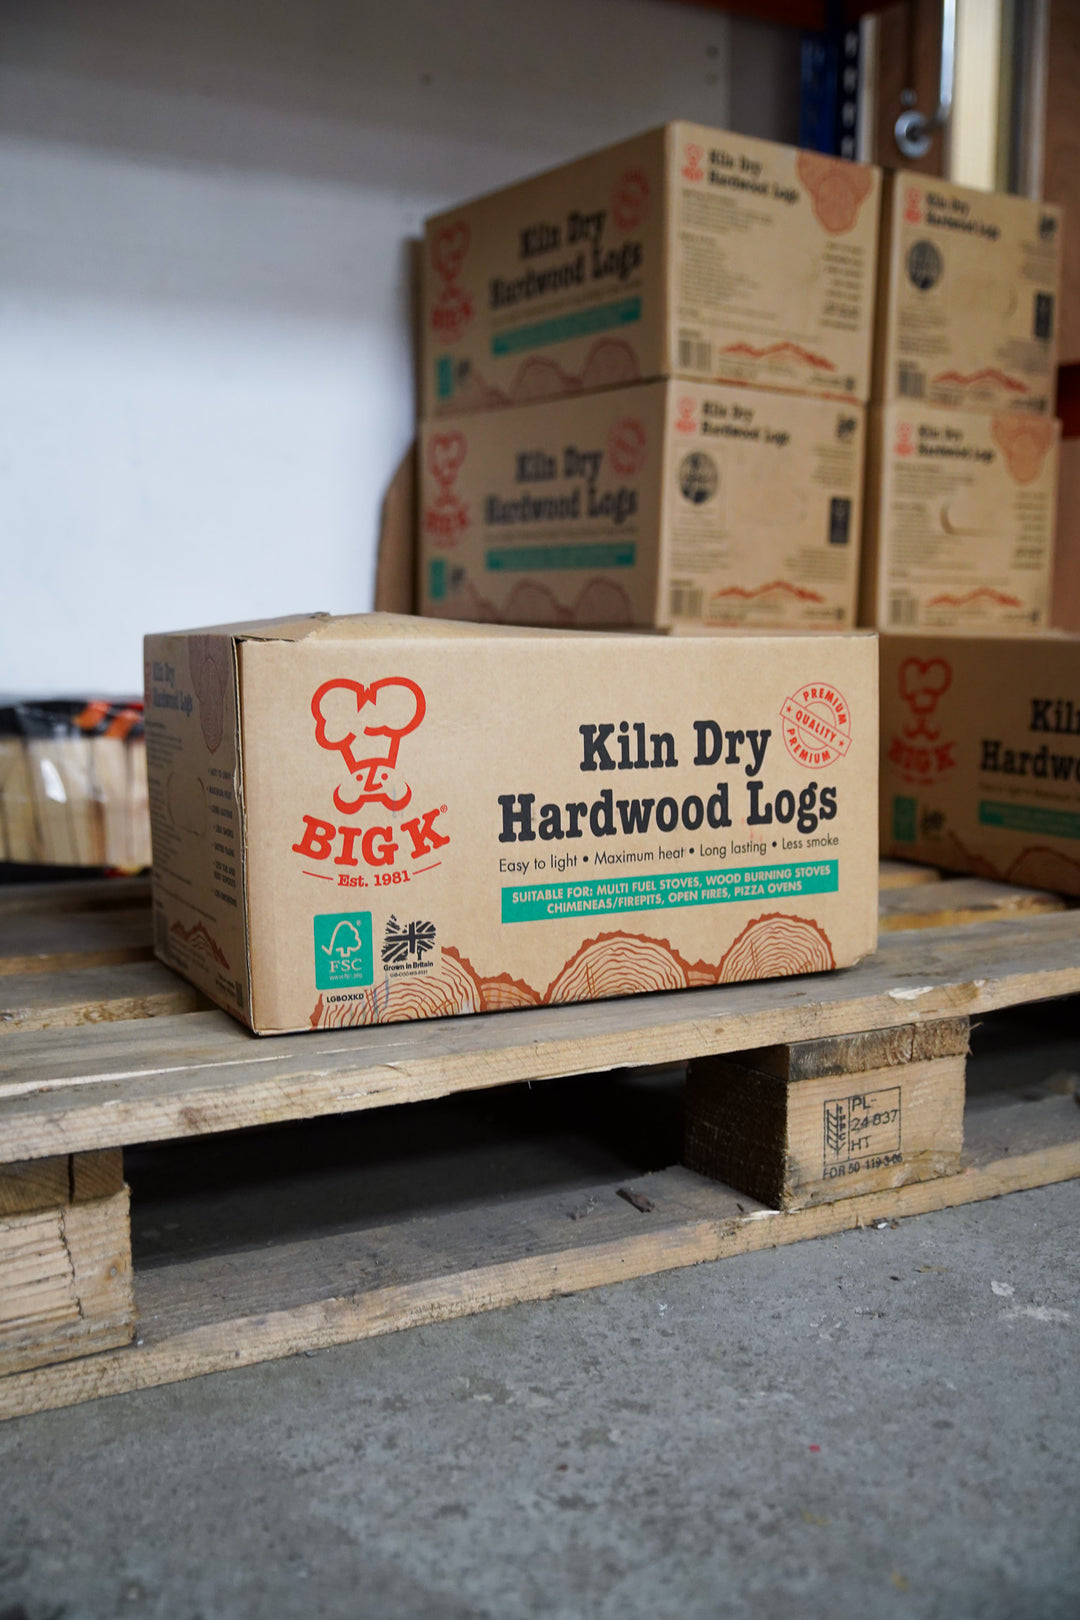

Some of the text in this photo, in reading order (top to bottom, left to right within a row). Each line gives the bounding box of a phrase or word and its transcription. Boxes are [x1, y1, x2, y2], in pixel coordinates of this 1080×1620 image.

[802, 687, 848, 726] PREMIUM
[795, 709, 838, 743] QUALITY
[579, 720, 772, 776] Kiln Dry
[786, 728, 831, 764] PREMIUM
[498, 781, 837, 842] Hardwood Logs
[292, 808, 450, 866] BIG K
[499, 833, 839, 875] Easy to light Maximum heat Long lasting Less smoke
[337, 870, 411, 887] Est. 1981
[512, 865, 831, 904] SUITABLE FOR: MULTI FUEL STOVES, WOOD BURNING STOVES
[668, 888, 698, 903] OPEN
[701, 887, 731, 899] FIRES,
[734, 884, 764, 896] PIZZA
[767, 881, 802, 893] OVENS
[329, 959, 362, 973] FSC
[383, 963, 405, 972] Grown
[413, 961, 434, 969] Britain
[851, 1135, 873, 1151] HT
